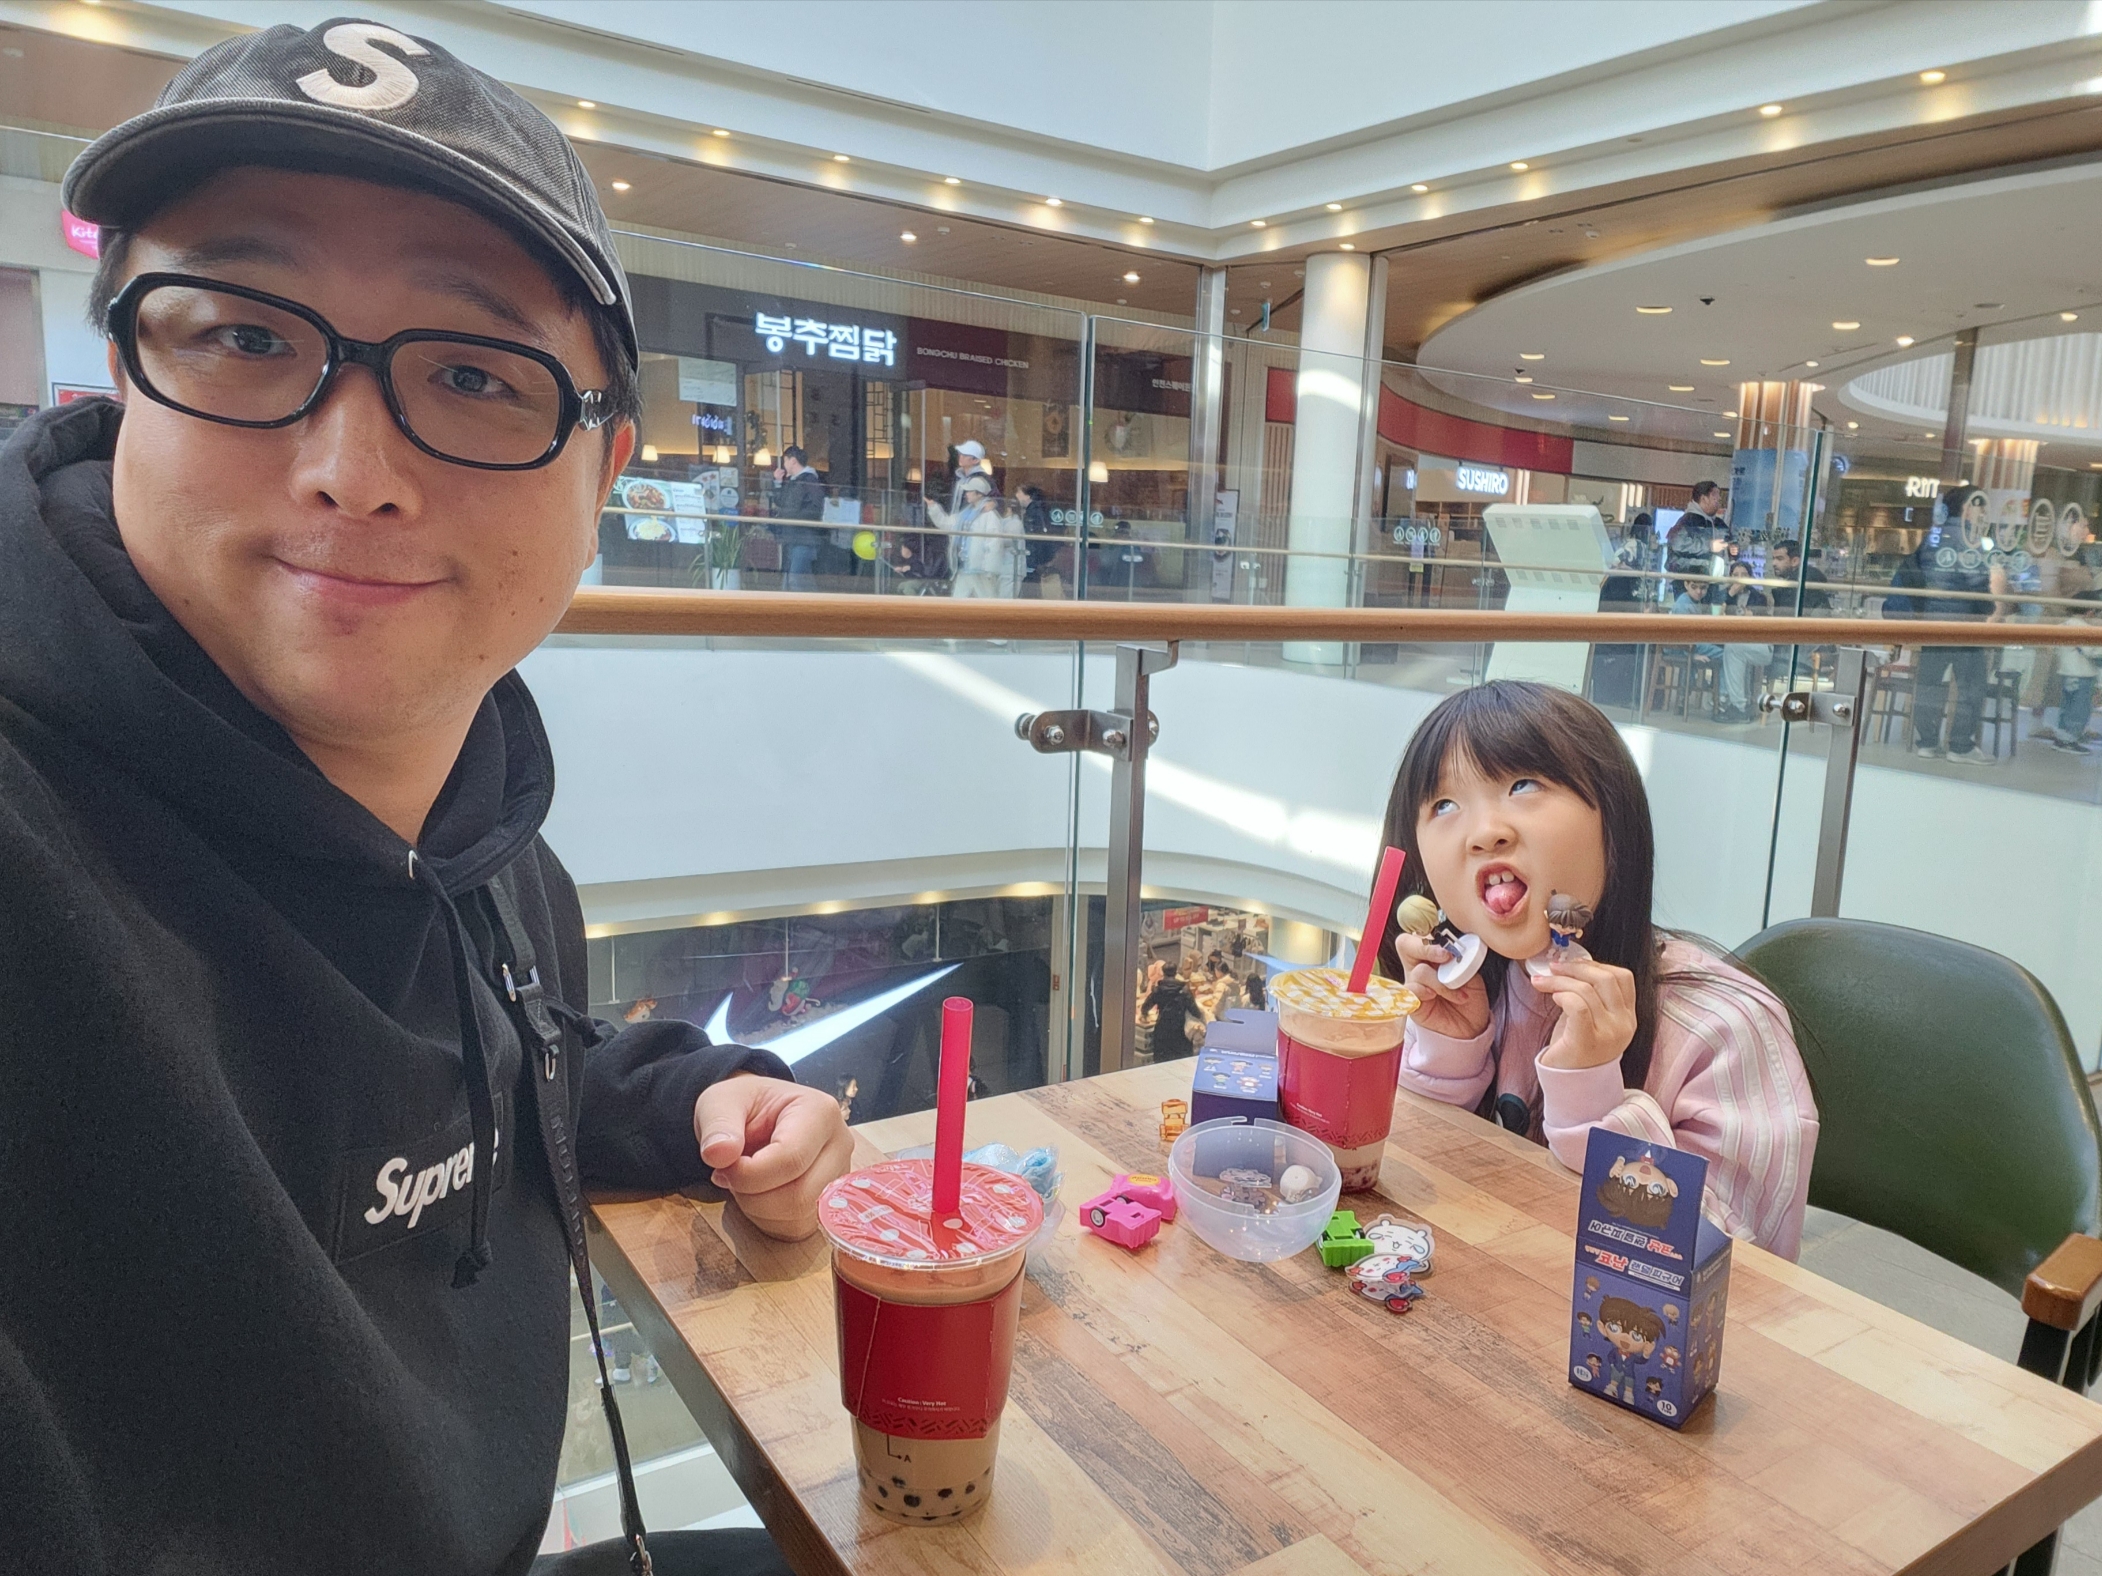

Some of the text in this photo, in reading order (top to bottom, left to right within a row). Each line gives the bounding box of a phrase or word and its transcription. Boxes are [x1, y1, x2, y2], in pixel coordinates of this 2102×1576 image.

[296, 23, 430, 109] S
[755, 312, 898, 367] 봉추찜닭
[917, 347, 1029, 369] BONGCHU BRAISED CHICKEN
[1457, 467, 1509, 495] SUSHIRO
[364, 1128, 499, 1229] Supre
[1596, 1250, 1629, 1272] 코난
[1652, 1267, 1685, 1286] 피규어
[1661, 1402, 1672, 1411] 10
[904, 1455, 912, 1463] A
